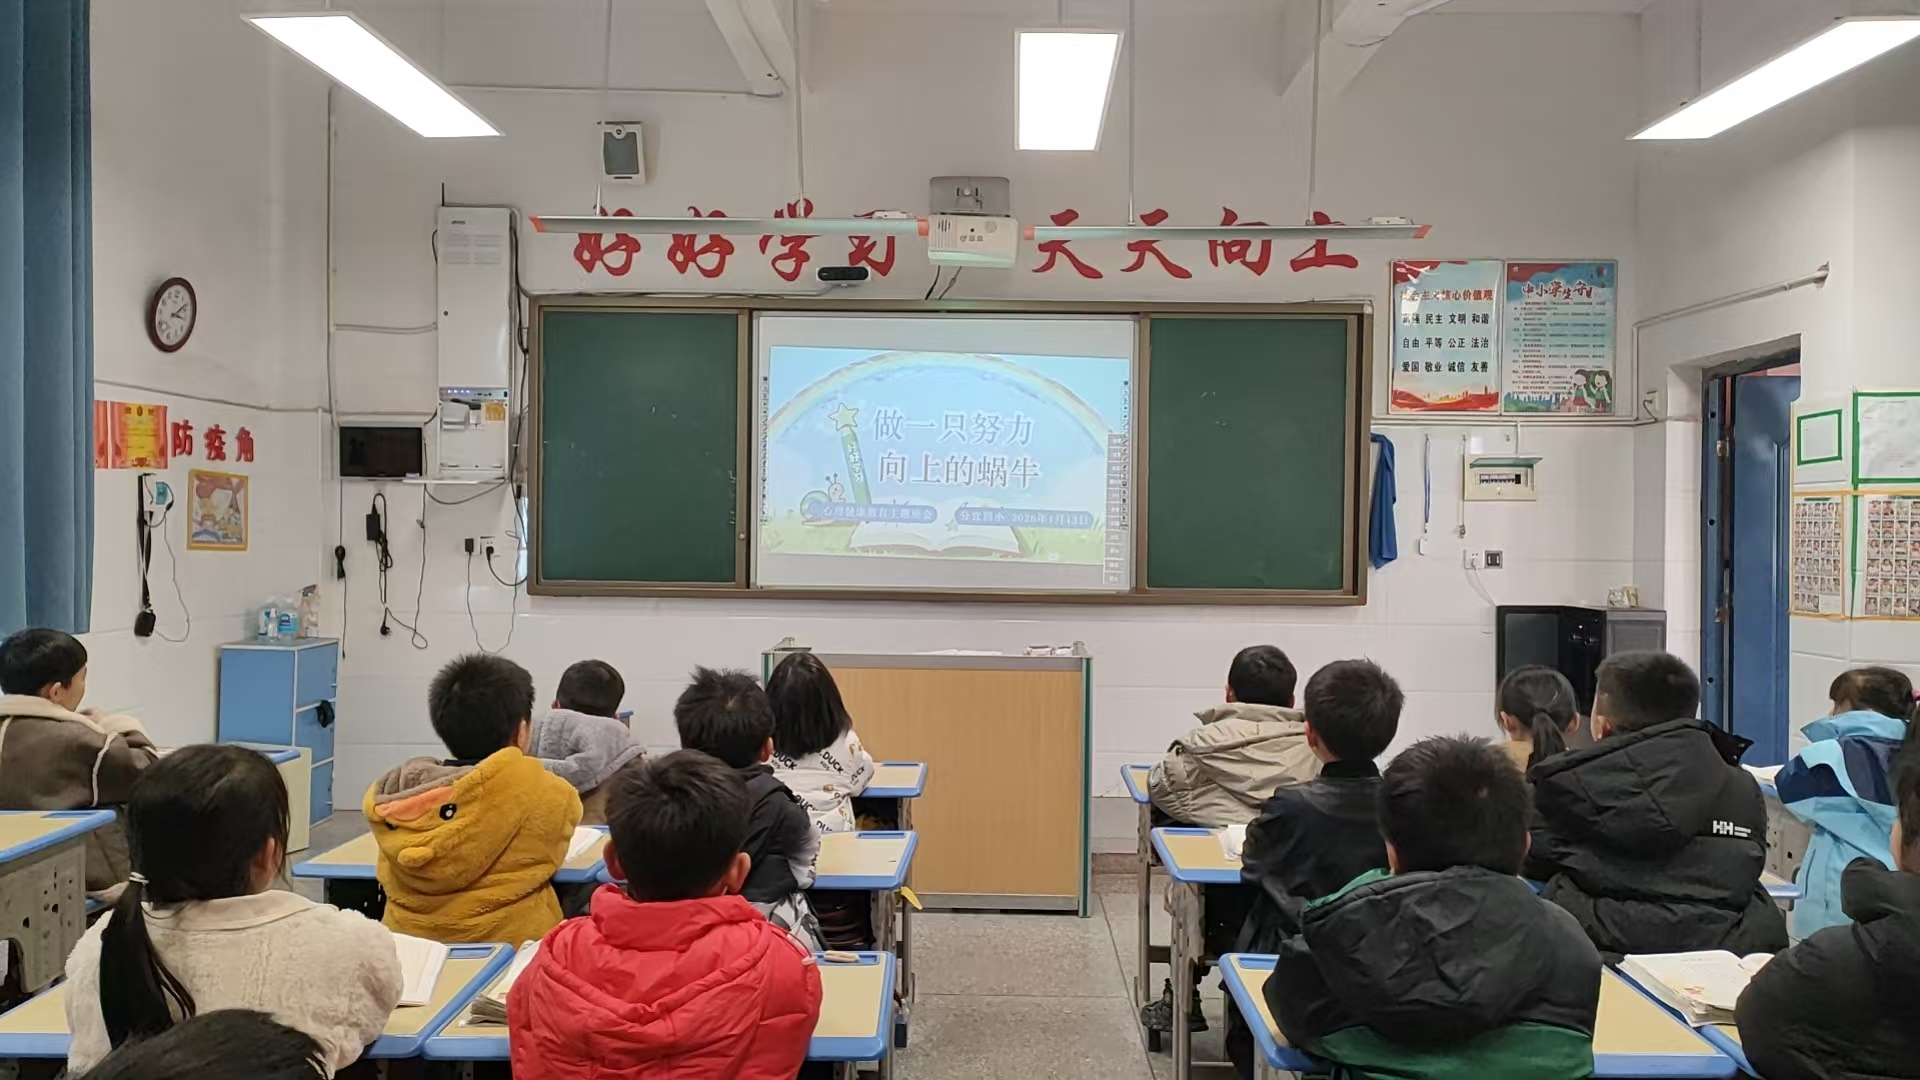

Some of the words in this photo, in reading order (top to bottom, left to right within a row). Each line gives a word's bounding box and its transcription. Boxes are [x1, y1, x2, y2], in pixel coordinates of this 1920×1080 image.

[1032, 207, 1358, 279] 天天向上
[1425, 312, 1443, 325] 民主
[1448, 312, 1467, 325] 文明
[1471, 312, 1490, 325] 和谐
[1402, 337, 1420, 349] 自由
[1425, 337, 1443, 349] 平等
[1448, 337, 1466, 349] 公正
[1471, 337, 1489, 349] 法治
[1402, 361, 1420, 373] 爱国
[1424, 361, 1443, 373] 敬业
[1447, 361, 1466, 373] 诚信
[1470, 361, 1489, 373] 友善
[873, 408, 1033, 446] 做一只努力
[171, 419, 255, 463] 防疫角
[879, 451, 1040, 489] 向上的蜗牛
[819, 750, 844, 774] .DUCK
[1712, 820, 1734, 836] HH
